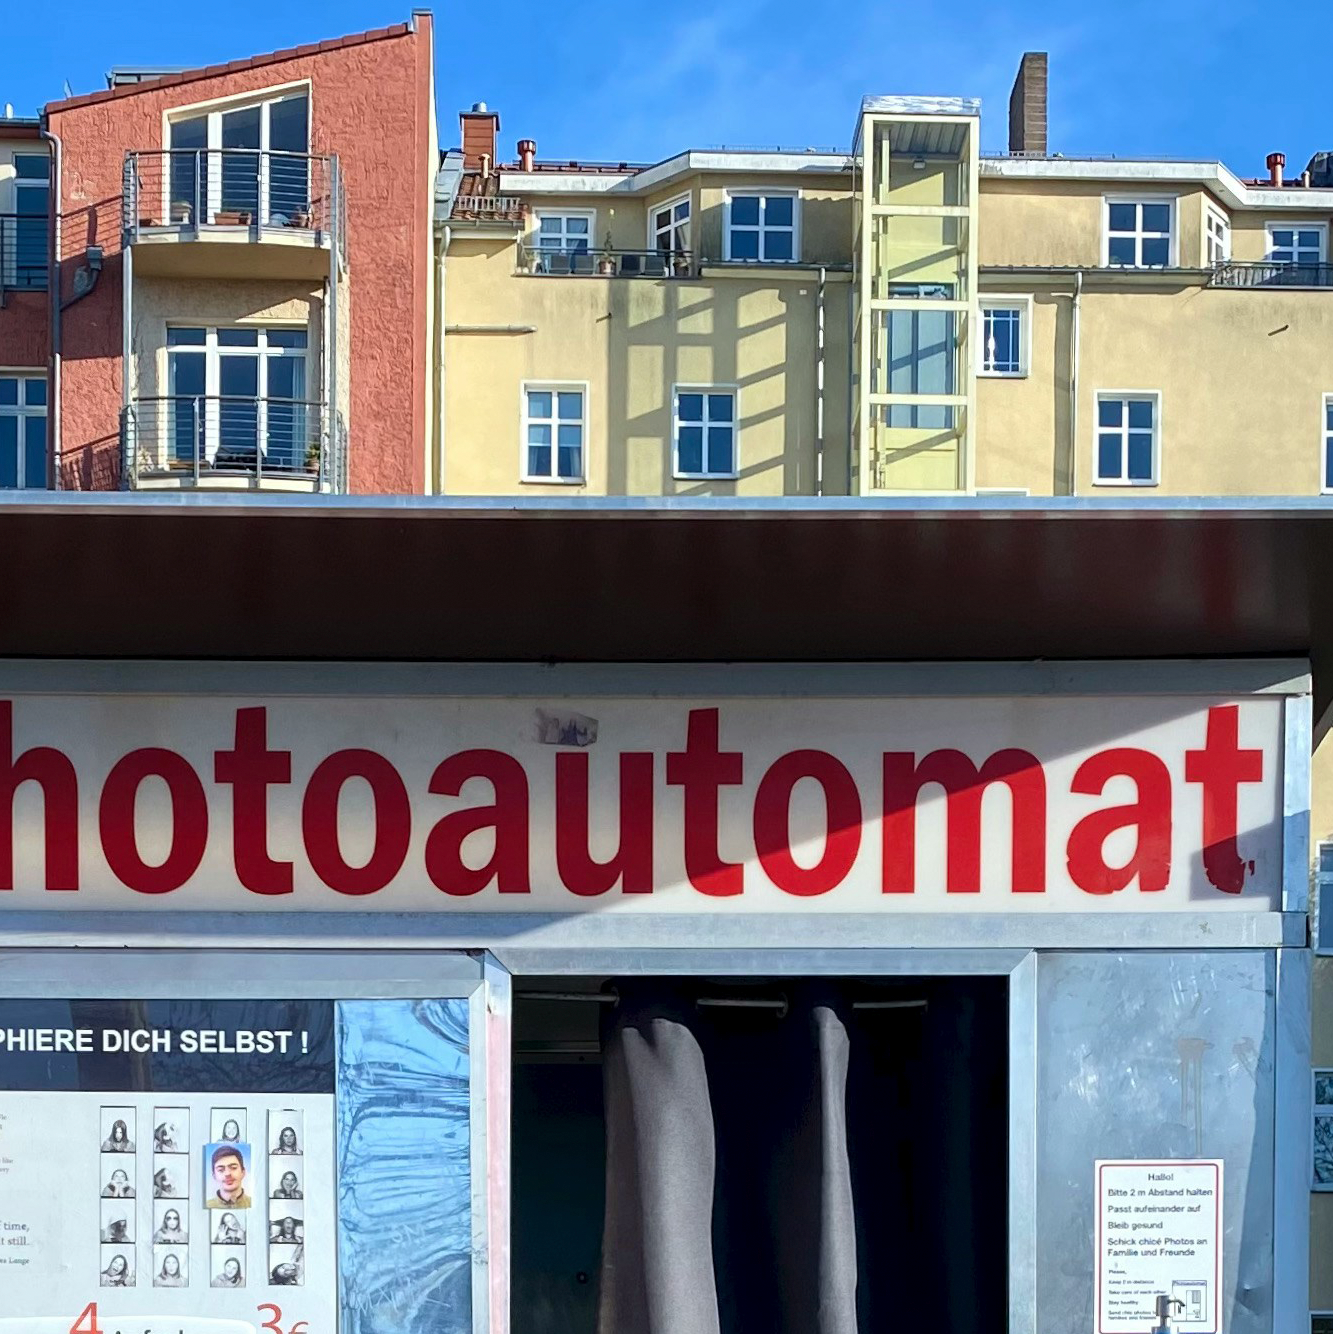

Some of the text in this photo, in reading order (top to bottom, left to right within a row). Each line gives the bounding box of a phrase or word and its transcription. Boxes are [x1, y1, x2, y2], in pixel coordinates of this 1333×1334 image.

[102, 1029, 168, 1052] DICH
[179, 1030, 293, 1053] SELBST
[4, 1222, 30, 1232] time,
[1132, 1222, 1163, 1231] gesund
[8, 1238, 30, 1246] still.
